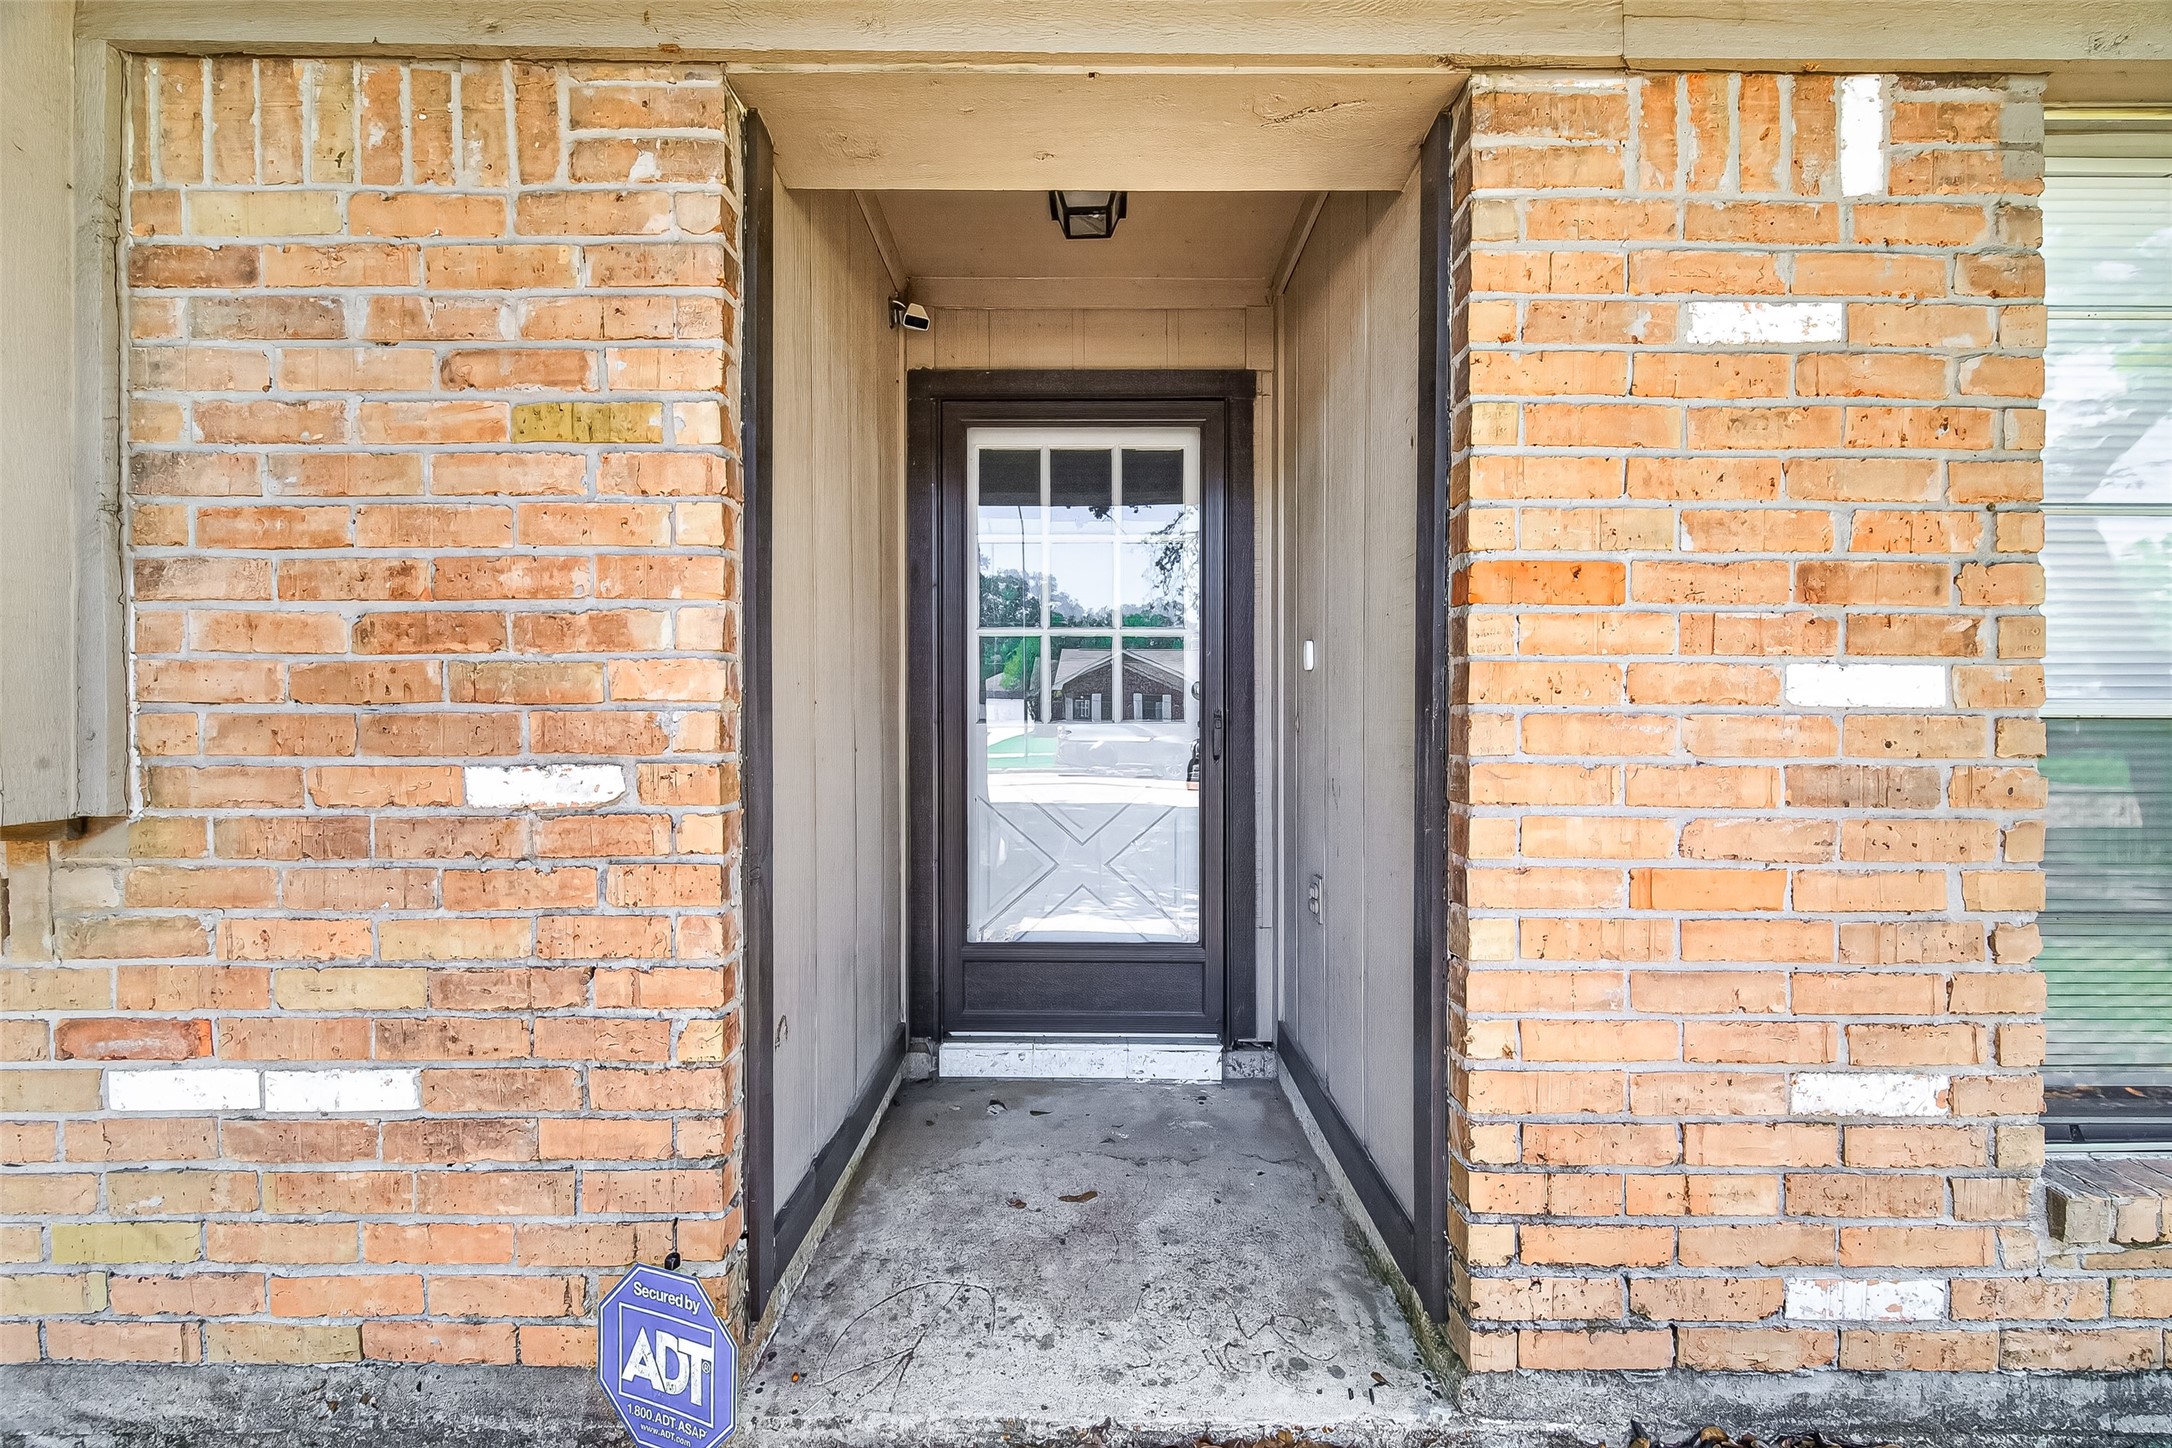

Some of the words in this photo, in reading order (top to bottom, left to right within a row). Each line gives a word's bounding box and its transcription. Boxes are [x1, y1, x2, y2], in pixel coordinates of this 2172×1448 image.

[633, 1281, 683, 1308] Secured
[684, 1294, 700, 1315] by
[622, 1326, 713, 1406] ADT
[627, 1403, 707, 1439] 1.800.ADT.ASAP
[640, 1423, 691, 1447] www.ADT.com
